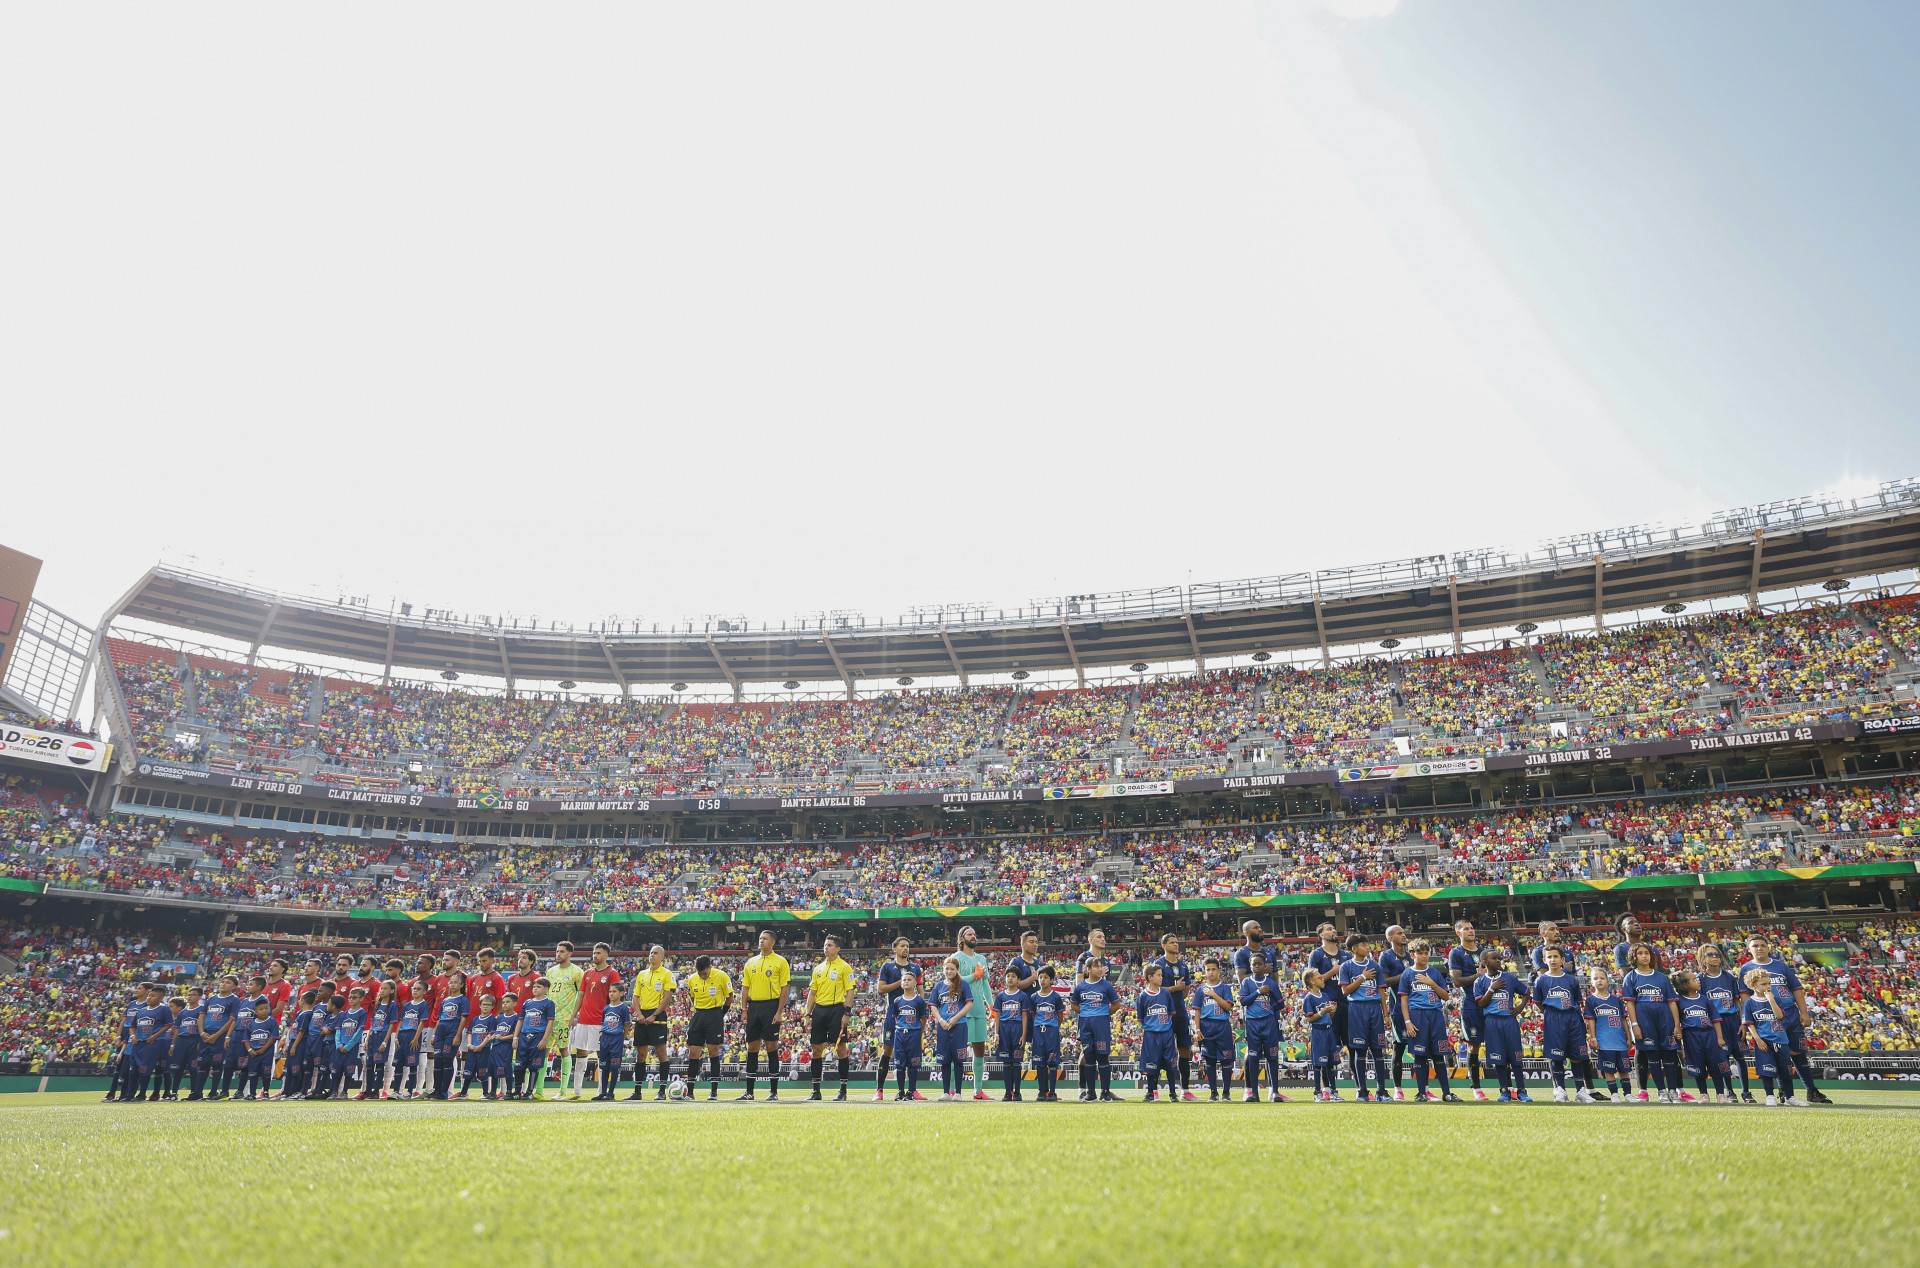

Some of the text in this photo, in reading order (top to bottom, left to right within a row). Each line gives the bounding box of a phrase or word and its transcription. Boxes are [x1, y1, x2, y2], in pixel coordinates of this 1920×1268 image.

[1864, 718, 1900, 729] ROAD
[0, 729, 63, 750] D TO 26
[1690, 728, 1812, 750] PAUL WARFIELD 42
[9, 746, 59, 758] TURKISH AIRLINES
[1525, 747, 1612, 765] JIM BROWN 32
[152, 771, 183, 780] MORTGAGE
[153, 766, 210, 779] CROSSCOUNTRY
[231, 778, 302, 795] LEN FORD 80
[1223, 775, 1285, 788] PAUL BROWN
[328, 789, 422, 806] CLAY MATTHEWS 57
[781, 796, 866, 808] DANTE LAVELLI 86
[943, 790, 1023, 802] OTTO GRAHAM 14
[457, 800, 478, 809] BILL
[516, 801, 529, 810] 60
[560, 801, 650, 810] MARION MOTLEY 36
[698, 800, 721, 810] 0:58
[474, 986, 483, 997] 14
[552, 983, 562, 992] 23
[591, 982, 596, 992] 7
[1609, 1016, 1621, 1028] 26
[559, 1028, 569, 1039] 23
